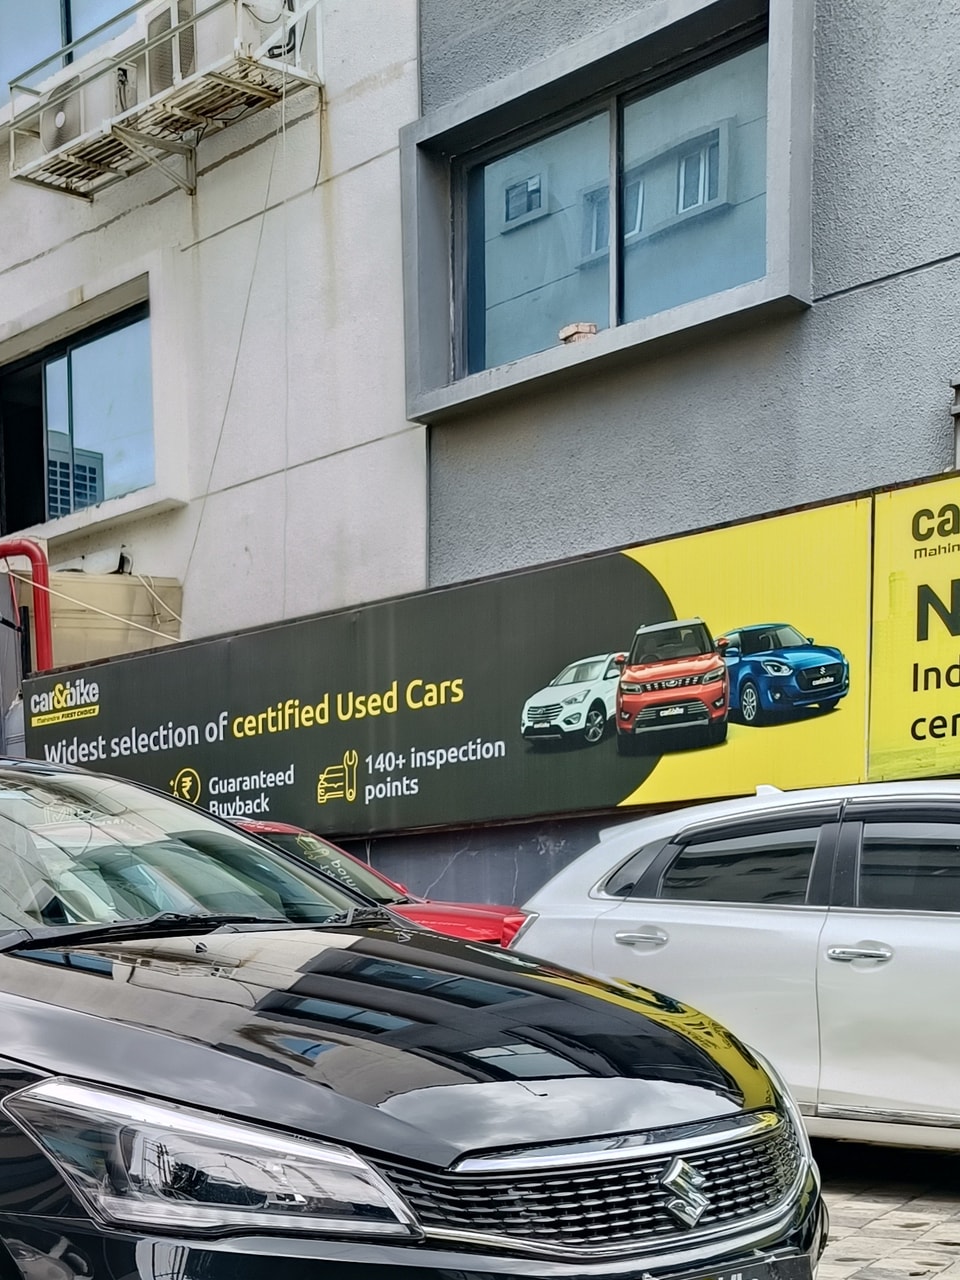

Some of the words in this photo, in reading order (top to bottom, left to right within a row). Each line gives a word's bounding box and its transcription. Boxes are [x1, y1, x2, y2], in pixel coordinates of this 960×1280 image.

[30, 678, 100, 714] car&bike
[43, 735, 107, 765] Widest
[110, 721, 199, 758] selection
[205, 711, 229, 744] of
[233, 692, 330, 738] certified
[337, 680, 398, 722] Used
[405, 678, 464, 710] Cars
[365, 752, 406, 774] 140+
[410, 737, 506, 770] inspection
[208, 763, 295, 795] Guaranteed
[365, 776, 419, 804] points
[209, 792, 270, 817] Buyback
